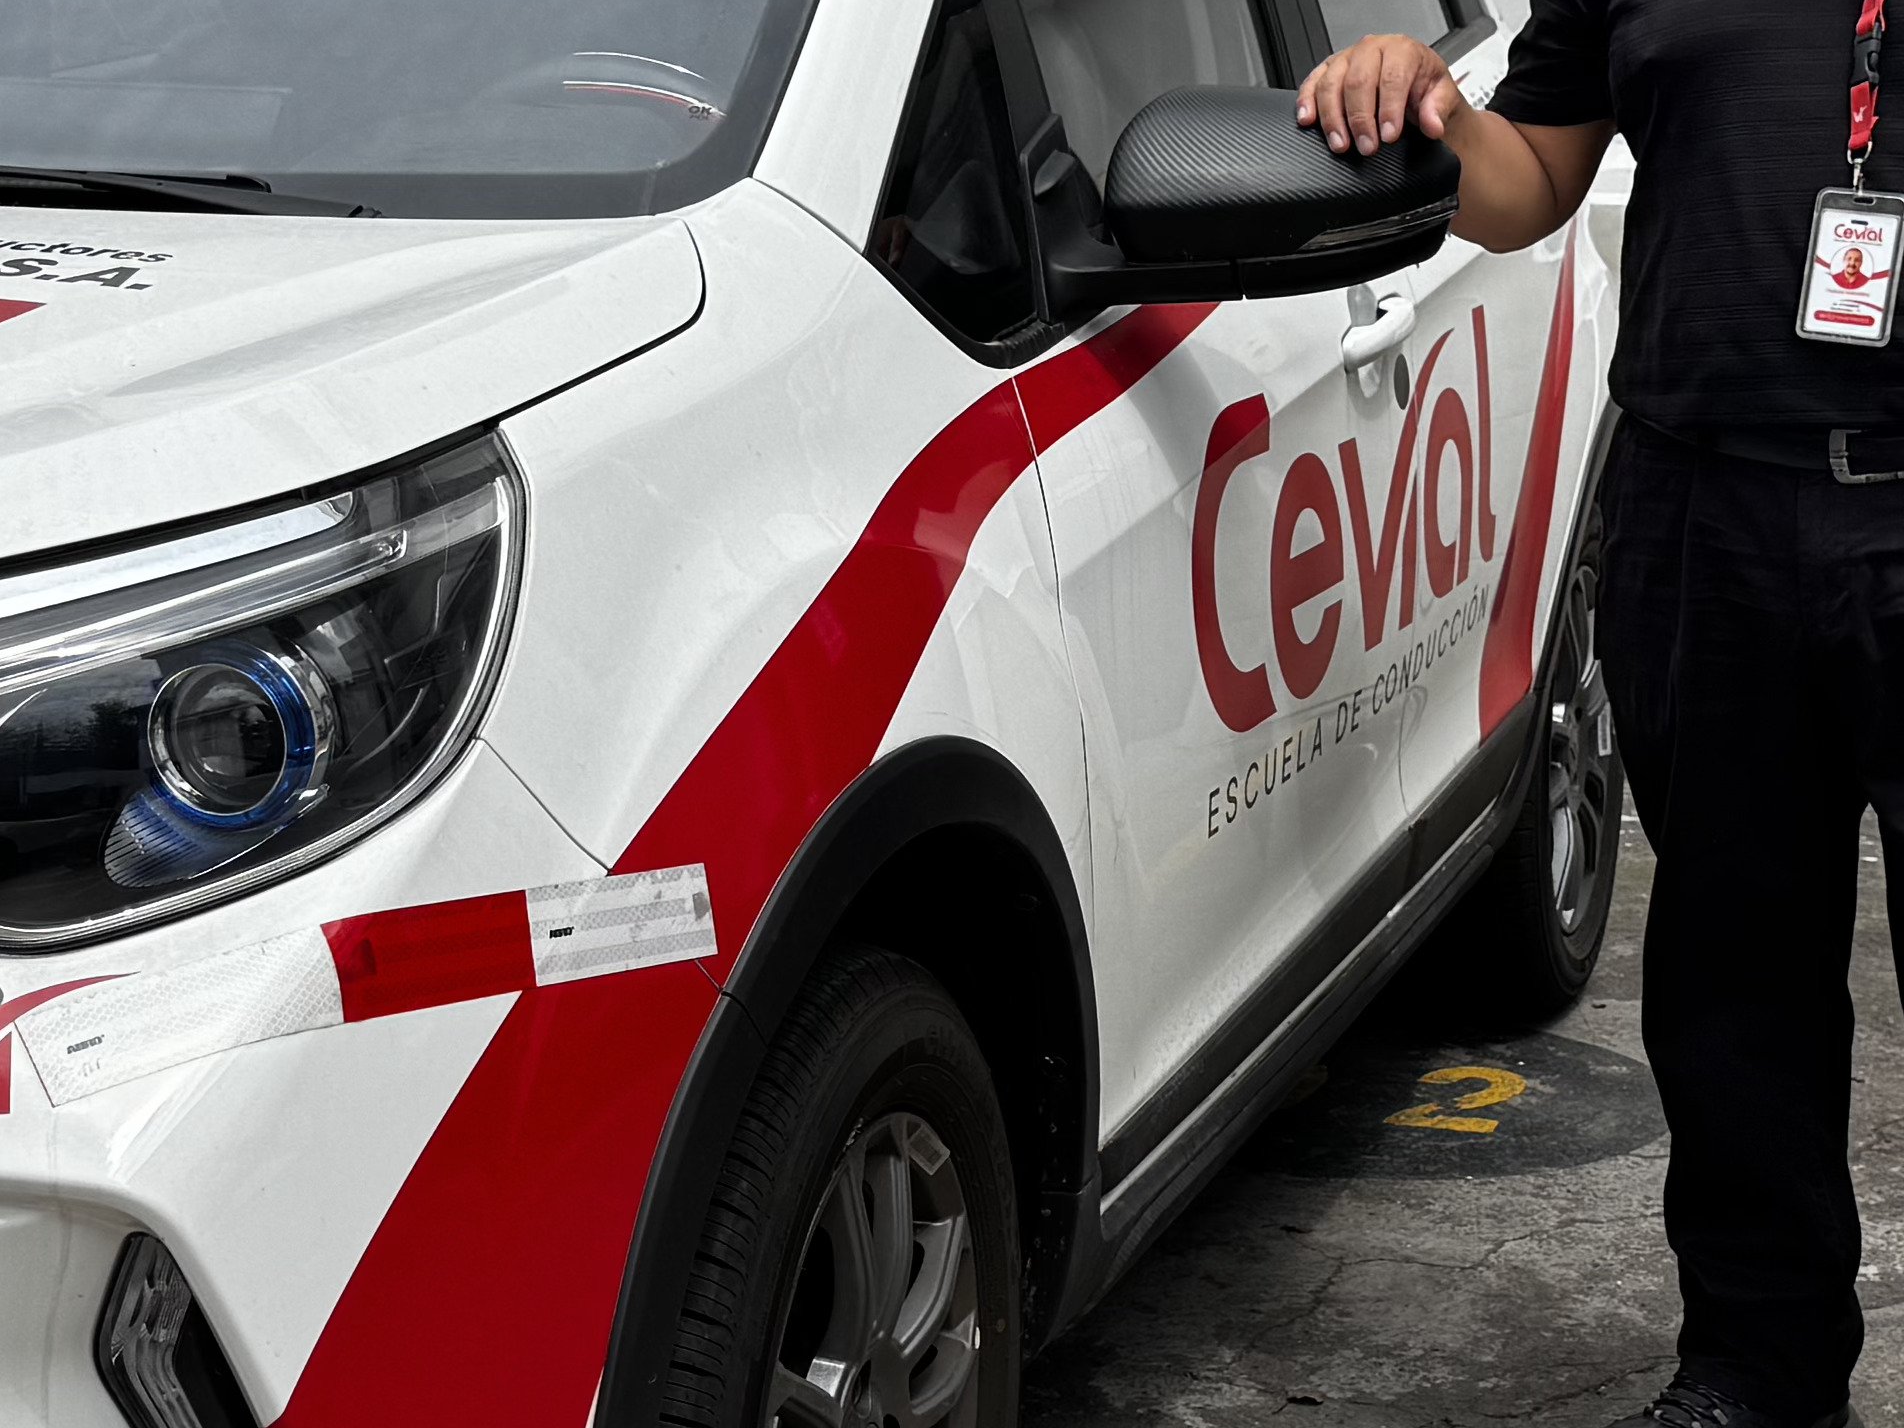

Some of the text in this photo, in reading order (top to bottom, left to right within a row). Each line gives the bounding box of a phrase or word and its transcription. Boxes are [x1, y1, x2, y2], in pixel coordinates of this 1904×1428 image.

[1191, 303, 1498, 733] Cevial
[1206, 582, 1491, 840] ESCUELA DE CONDUCCIÓN
